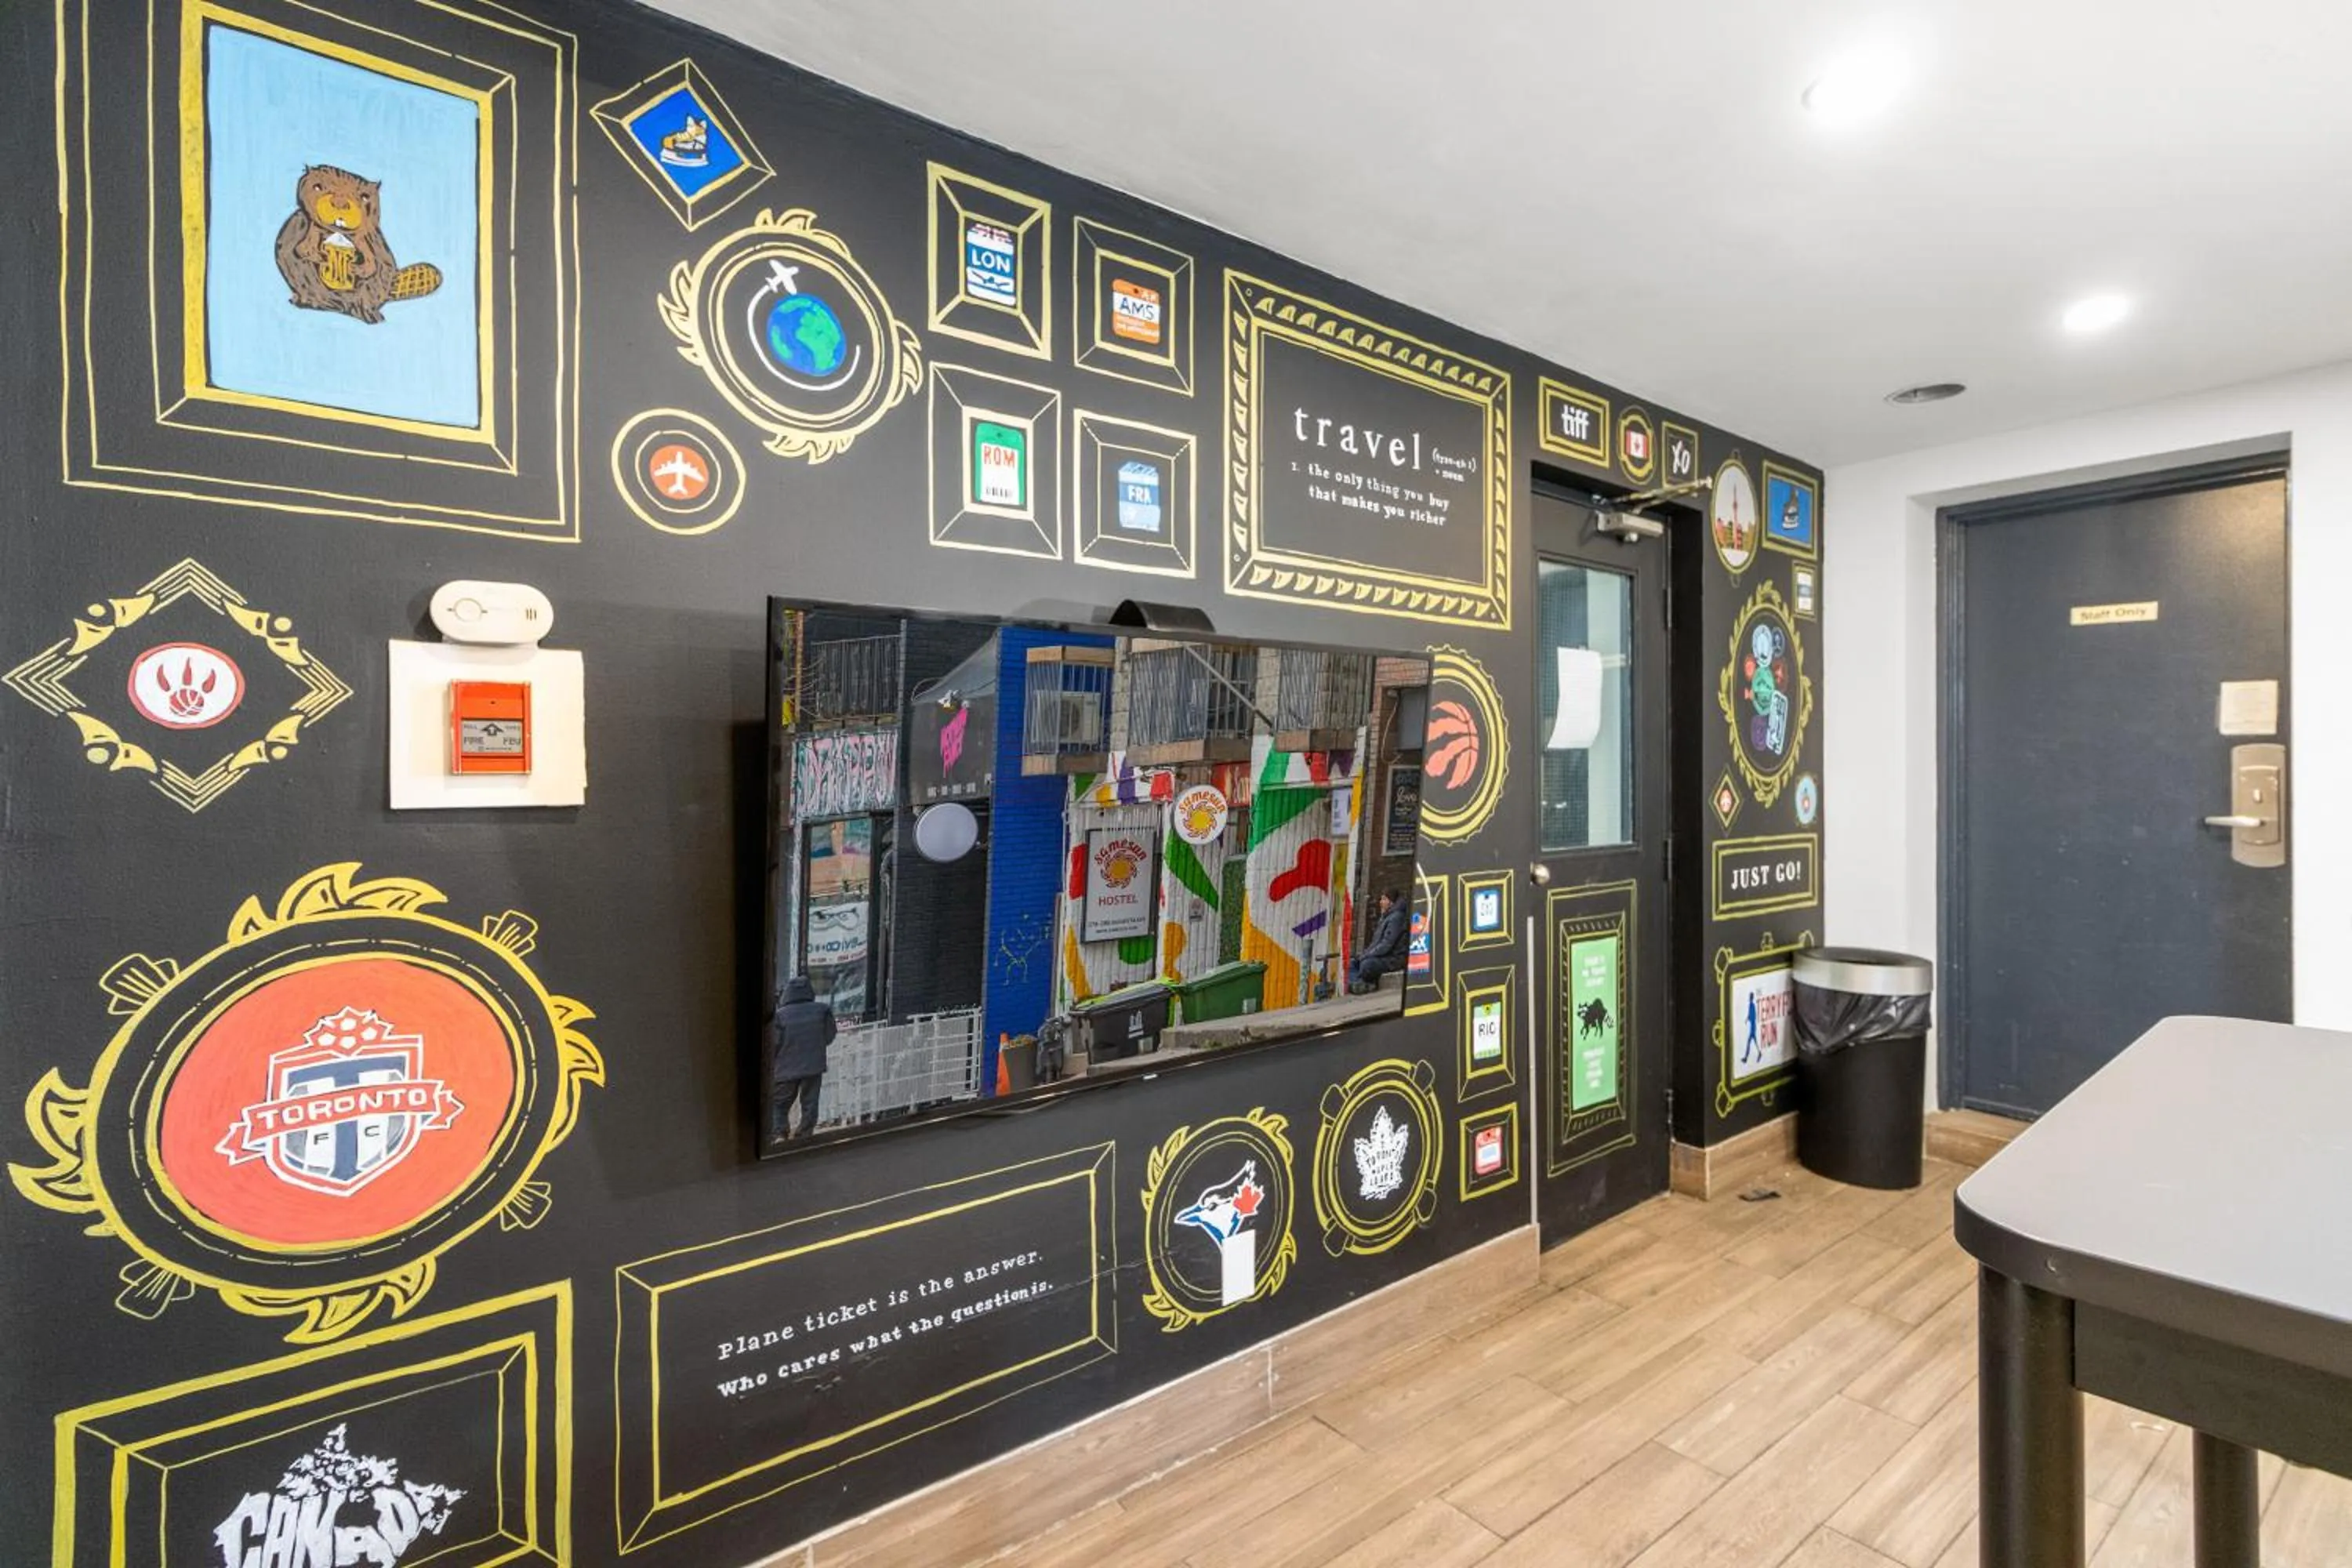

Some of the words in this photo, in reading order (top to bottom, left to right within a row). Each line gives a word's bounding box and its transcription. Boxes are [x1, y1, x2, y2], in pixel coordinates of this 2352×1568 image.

[971, 247, 1011, 274] LON
[1120, 296, 1155, 321] AMS
[1294, 407, 1421, 470] travel
[1561, 404, 1590, 441] tiff
[983, 444, 1015, 469] ROM
[1127, 484, 1152, 506] FRA
[1308, 463, 1330, 480] the
[1334, 471, 1363, 490] only
[1367, 477, 1400, 499] thing
[1403, 487, 1424, 503] you
[1428, 492, 1450, 512] buy
[1308, 485, 1338, 503] that
[1341, 494, 1380, 514] makes
[1382, 504, 1406, 520] you
[1409, 509, 1447, 527] richer
[1730, 865, 1770, 891] JUST
[1775, 860, 1802, 884] GO!
[1098, 894, 1139, 907] HOSTEL
[256, 1087, 427, 1131] TORONTO
[717, 1323, 796, 1361] Plane
[804, 1296, 879, 1334] ticket
[887, 1288, 909, 1308] is
[917, 1276, 955, 1298] the
[963, 1249, 1044, 1286] answer.
[777, 1347, 840, 1378] cares
[849, 1326, 902, 1355] what
[908, 1312, 944, 1334] the
